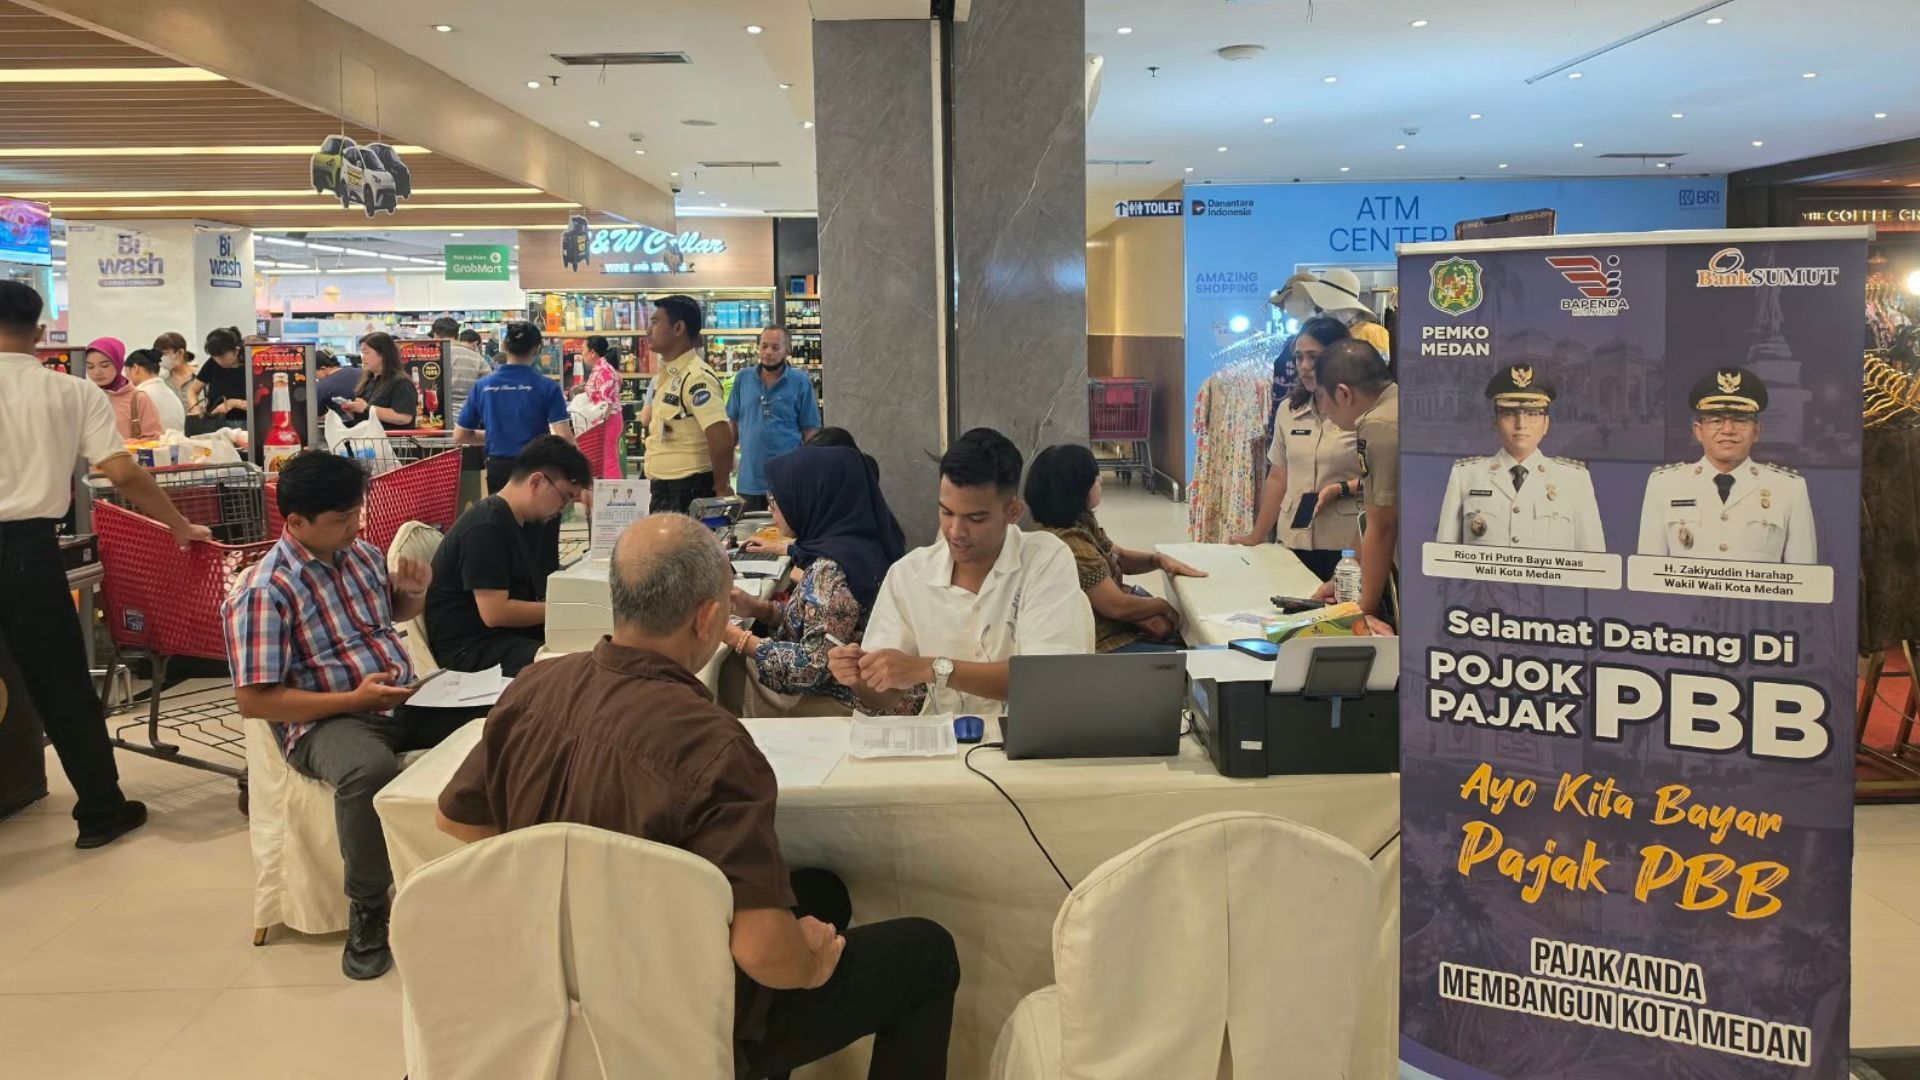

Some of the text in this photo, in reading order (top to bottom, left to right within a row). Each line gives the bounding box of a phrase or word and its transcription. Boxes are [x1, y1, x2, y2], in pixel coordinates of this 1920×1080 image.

[1208, 199, 1254, 207] Danantara
[1697, 190, 1719, 204] BRI
[1144, 202, 1181, 214] TOILET
[1208, 208, 1252, 216] Indonesia
[1357, 196, 1419, 220] ATM
[118, 233, 140, 255] Bi
[219, 234, 231, 256] Bi
[98, 252, 164, 274] wash
[209, 256, 242, 277] wash
[453, 263, 502, 273] GrabMart
[1196, 272, 1258, 283] AMAZING
[1196, 284, 1258, 294] SHOPPING
[1562, 299, 1628, 309] BAPENDA
[1422, 326, 1489, 339] PEMKO
[1421, 343, 1490, 356] MEDAN
[1454, 550, 1584, 567] Rico Tri Putra Bayu Waas
[1475, 566, 1561, 580] Wali Kota Medan
[1664, 564, 1794, 581] H. Zakiyuddin Harahap
[1664, 578, 1794, 596] Wakil Wali Kota Medan
[1449, 610, 1794, 662] Selamat Datang Di
[1430, 652, 1582, 694] POJOK
[1430, 693, 1576, 733] PAJAK
[1596, 667, 1829, 759] PBB
[1460, 763, 1782, 843] Ayo Kita Bayar
[1457, 820, 1790, 919] Pajak PBB
[1535, 943, 1702, 999] PAJAK ANDA
[1443, 968, 1807, 1062] MEMBANGUN KOTA MEDAN
